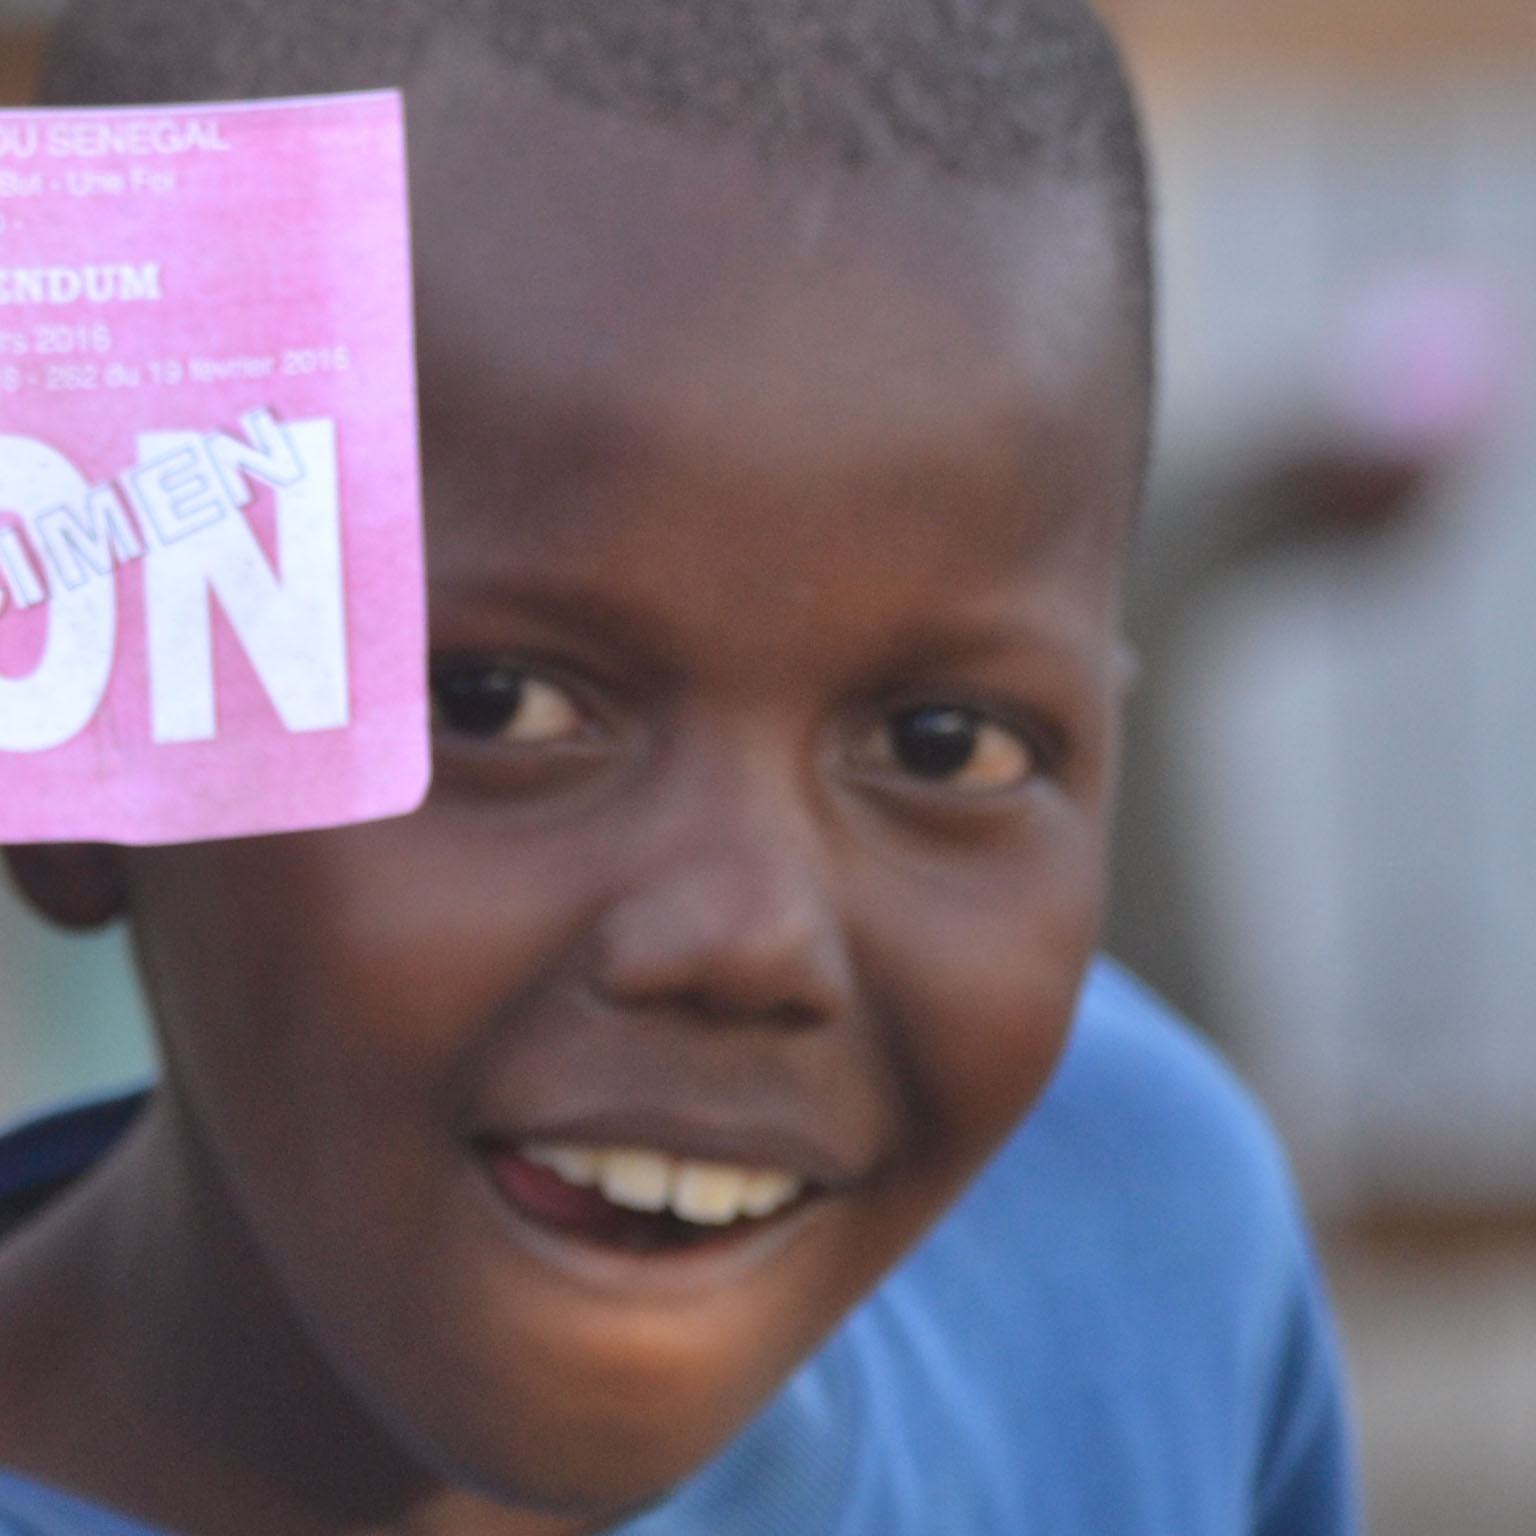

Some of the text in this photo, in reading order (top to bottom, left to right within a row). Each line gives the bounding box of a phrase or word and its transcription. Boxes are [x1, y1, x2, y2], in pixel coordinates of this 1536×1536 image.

[47, 118, 230, 157] SENEGAL
[66, 170, 125, 197] Une
[35, 324, 111, 354] 2016
[103, 361, 141, 388] du
[282, 346, 350, 376] 2016
